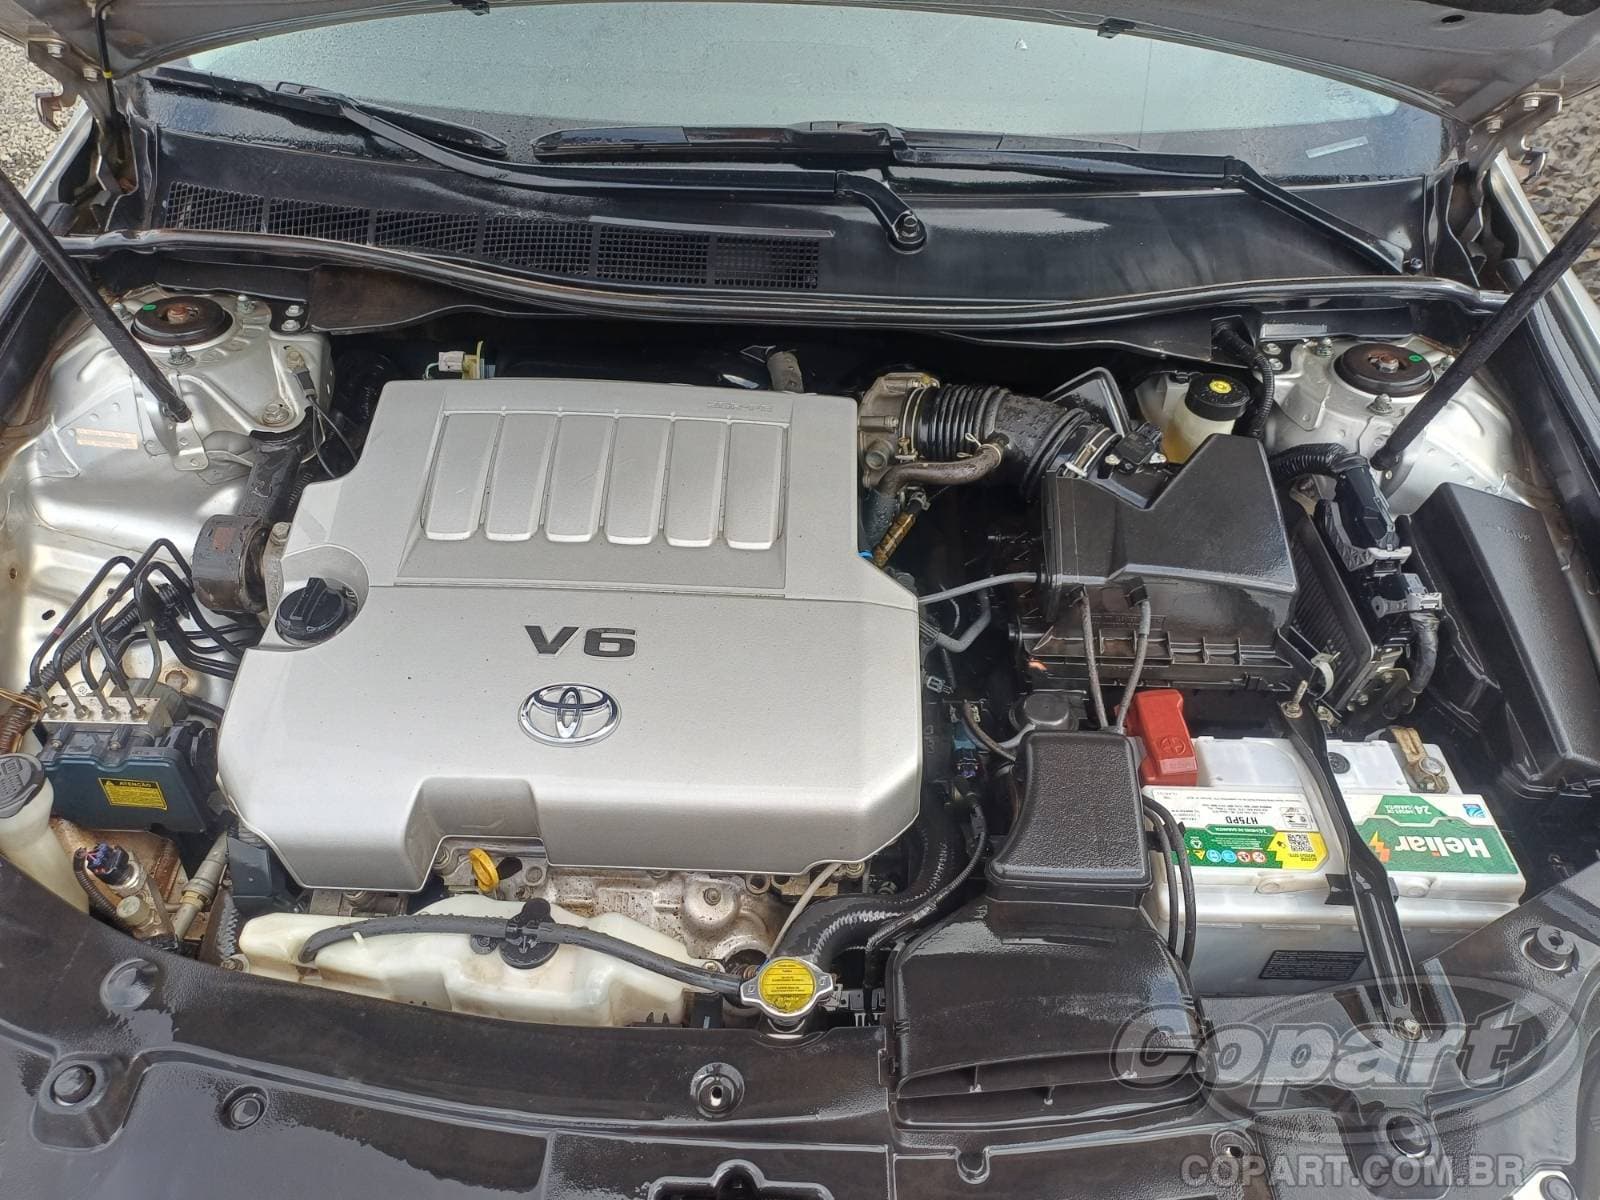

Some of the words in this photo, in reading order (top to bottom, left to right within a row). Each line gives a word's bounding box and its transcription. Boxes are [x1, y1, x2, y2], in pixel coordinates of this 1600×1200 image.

[524, 625, 636, 658] V6
[1414, 804, 1433, 816] 24
[1394, 835, 1492, 858] Heliar
